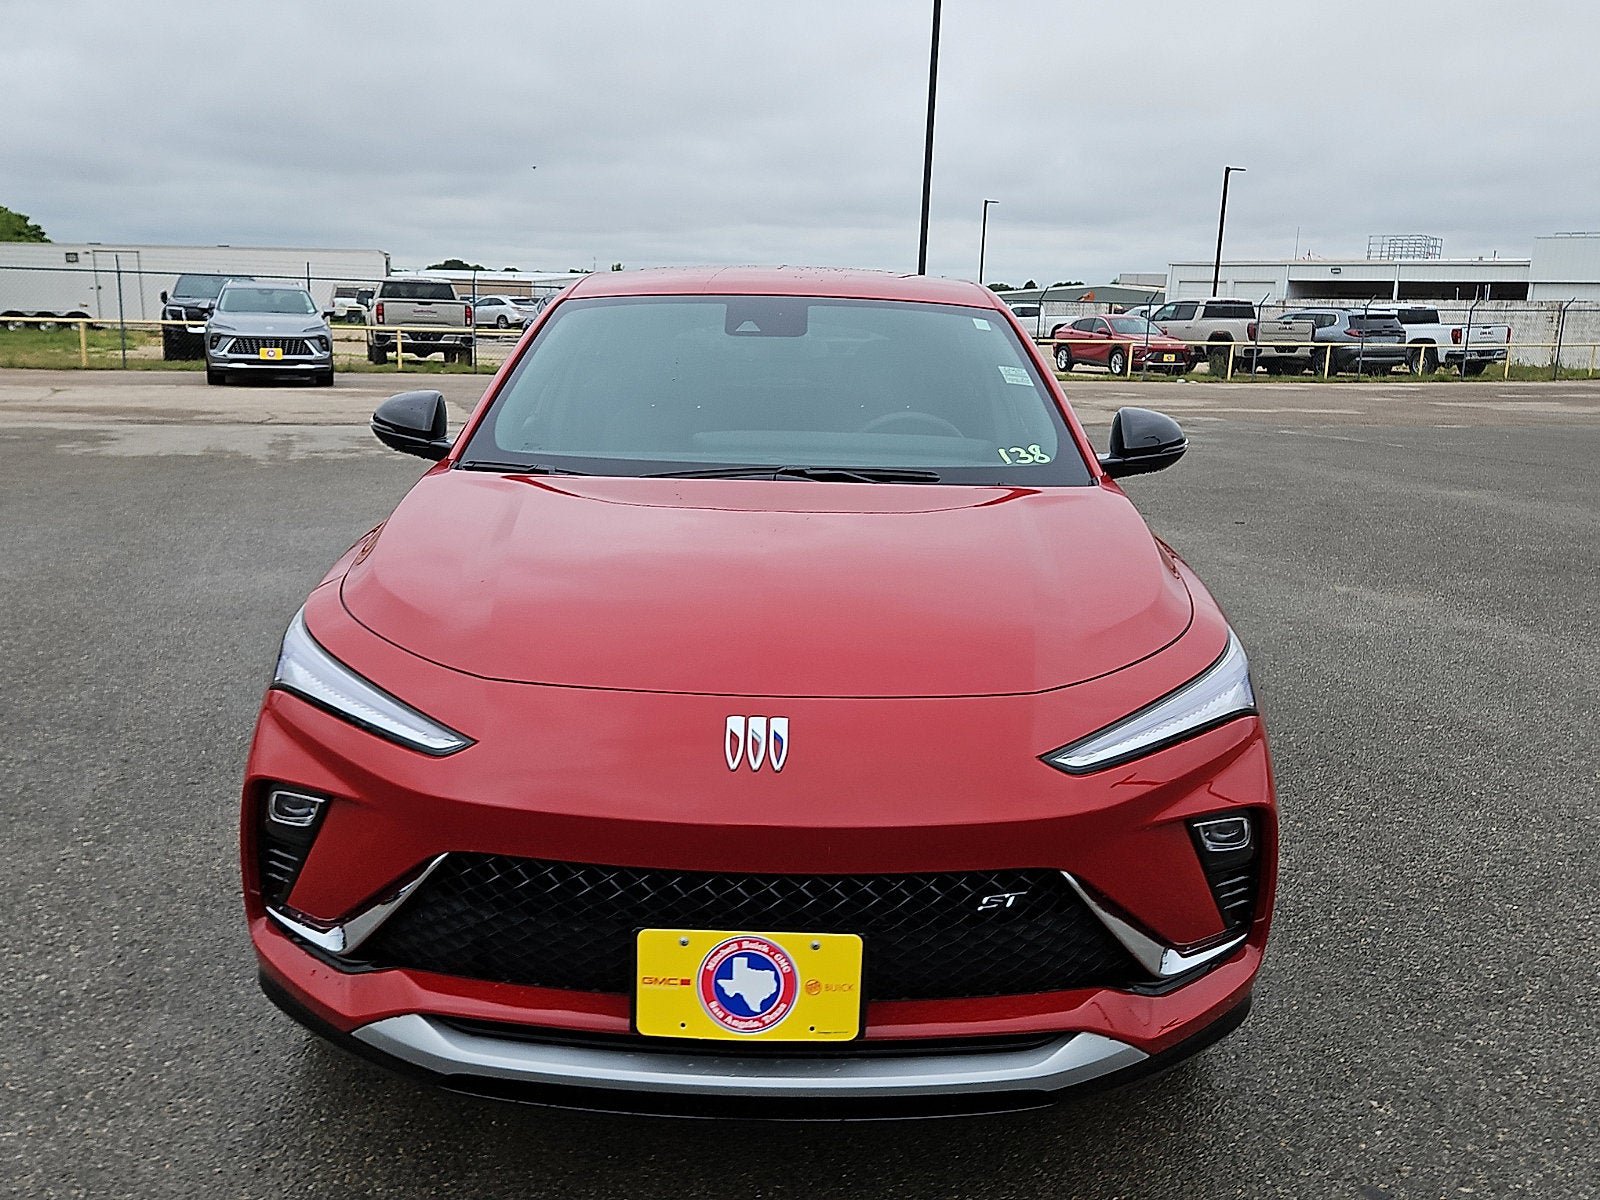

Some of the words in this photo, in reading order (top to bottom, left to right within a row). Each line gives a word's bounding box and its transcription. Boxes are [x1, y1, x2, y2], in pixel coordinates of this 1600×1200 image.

[998, 444, 1051, 465] 138
[977, 891, 1028, 911] ST
[642, 976, 678, 985] GMC
[824, 983, 854, 992] BUICK
